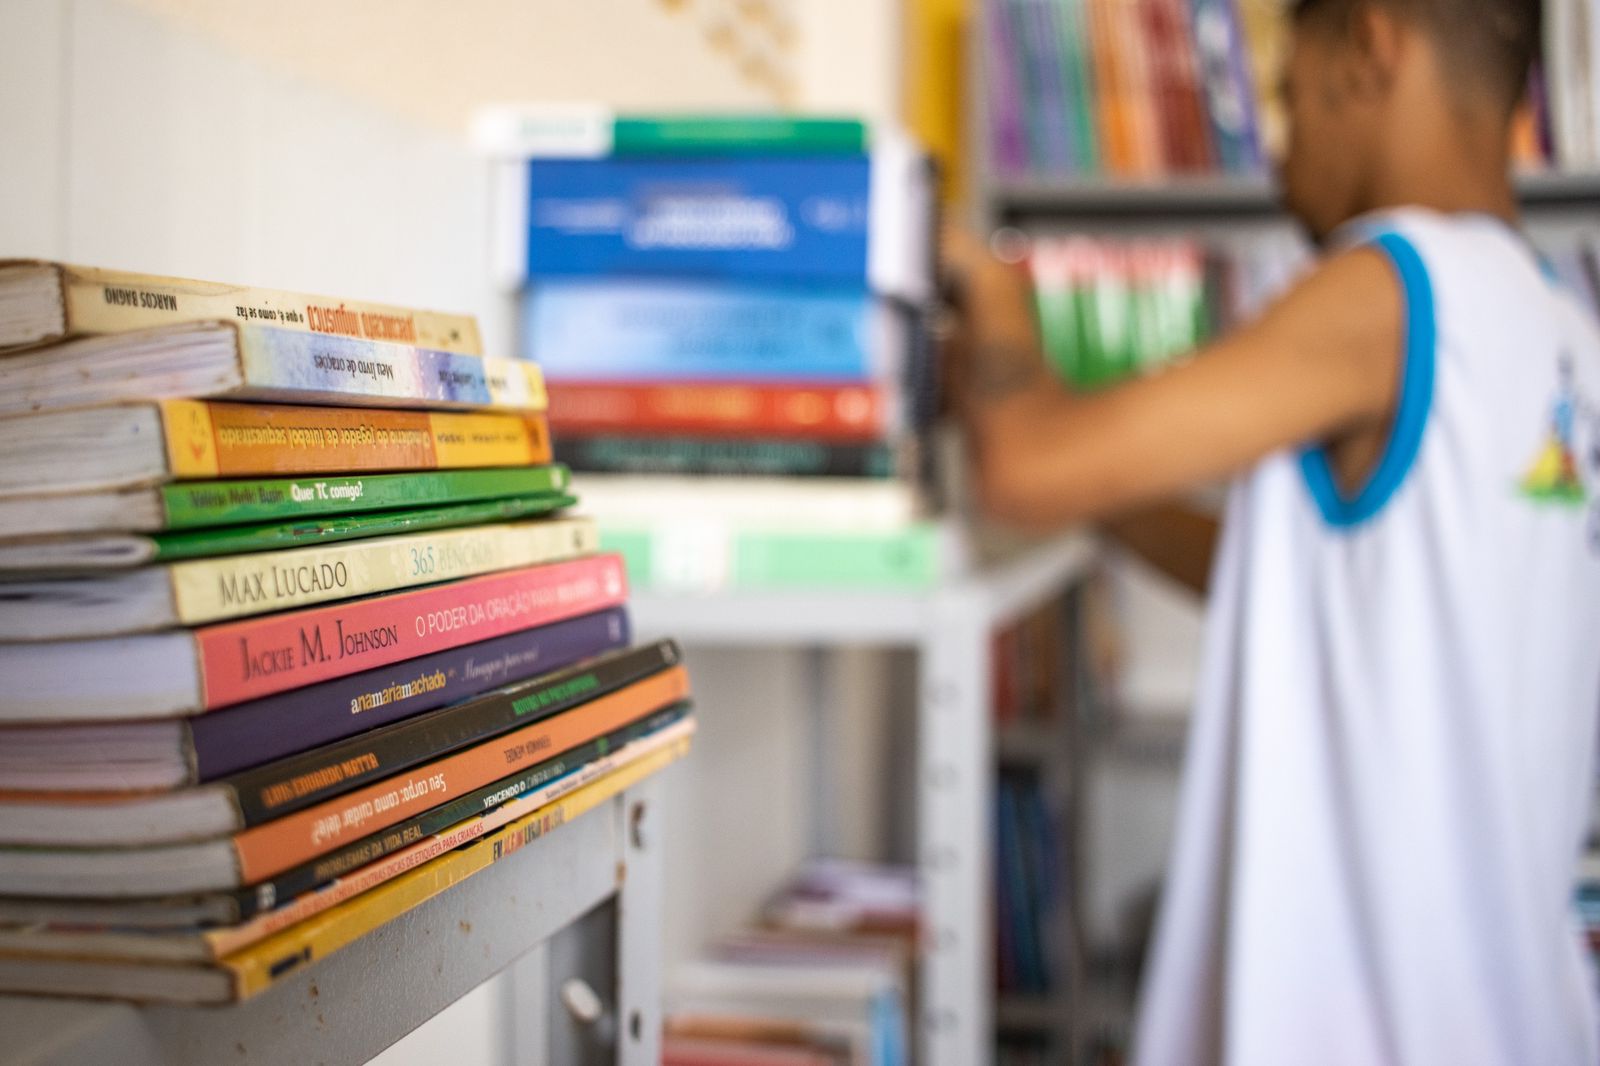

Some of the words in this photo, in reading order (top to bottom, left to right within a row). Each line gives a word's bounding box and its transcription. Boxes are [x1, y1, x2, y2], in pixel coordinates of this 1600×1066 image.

[104, 287, 139, 307] BAGNO
[140, 291, 178, 311] MARCOS
[236, 305, 248, 321] faz
[249, 307, 257, 318] se
[258, 308, 277, 321] como
[285, 313, 299, 325] que
[300, 313, 304, 323] o
[313, 353, 346, 374] orações
[346, 360, 358, 378] de
[358, 359, 377, 380] livro
[376, 362, 394, 381] Meu
[219, 422, 287, 449] sequestrado
[288, 425, 325, 449] futebol
[325, 426, 339, 448] de
[340, 423, 375, 449] jogador
[376, 428, 389, 448] do
[291, 483, 314, 502] Quer
[314, 482, 329, 500] TC
[329, 480, 364, 502] comigo?
[411, 546, 435, 576] 365
[219, 571, 267, 606] MAX
[272, 561, 348, 598] LUCADO
[415, 615, 426, 637] O
[427, 605, 468, 635] PODER
[469, 605, 486, 625] DA
[486, 591, 529, 620] ORAÇÃO
[238, 635, 295, 682] JACKIE
[300, 623, 332, 667] M.
[336, 619, 399, 660] JOHNSON
[350, 669, 447, 715] anamariamachado
[342, 752, 380, 777] MATTA
[400, 780, 428, 804] corpo:
[429, 773, 447, 792] Seu
[374, 791, 400, 813] como
[483, 785, 519, 809] VENCENDO
[519, 780, 526, 791] O
[342, 802, 373, 827] cuidar
[311, 814, 342, 846] dele?
[370, 840, 384, 857] DA
[383, 833, 403, 851] VIDA
[403, 825, 424, 844] REAL
[405, 853, 416, 868] DE
[415, 840, 442, 863] ETIQUETA
[442, 833, 457, 850] PARA
[458, 822, 485, 845] CRIANÇAS
